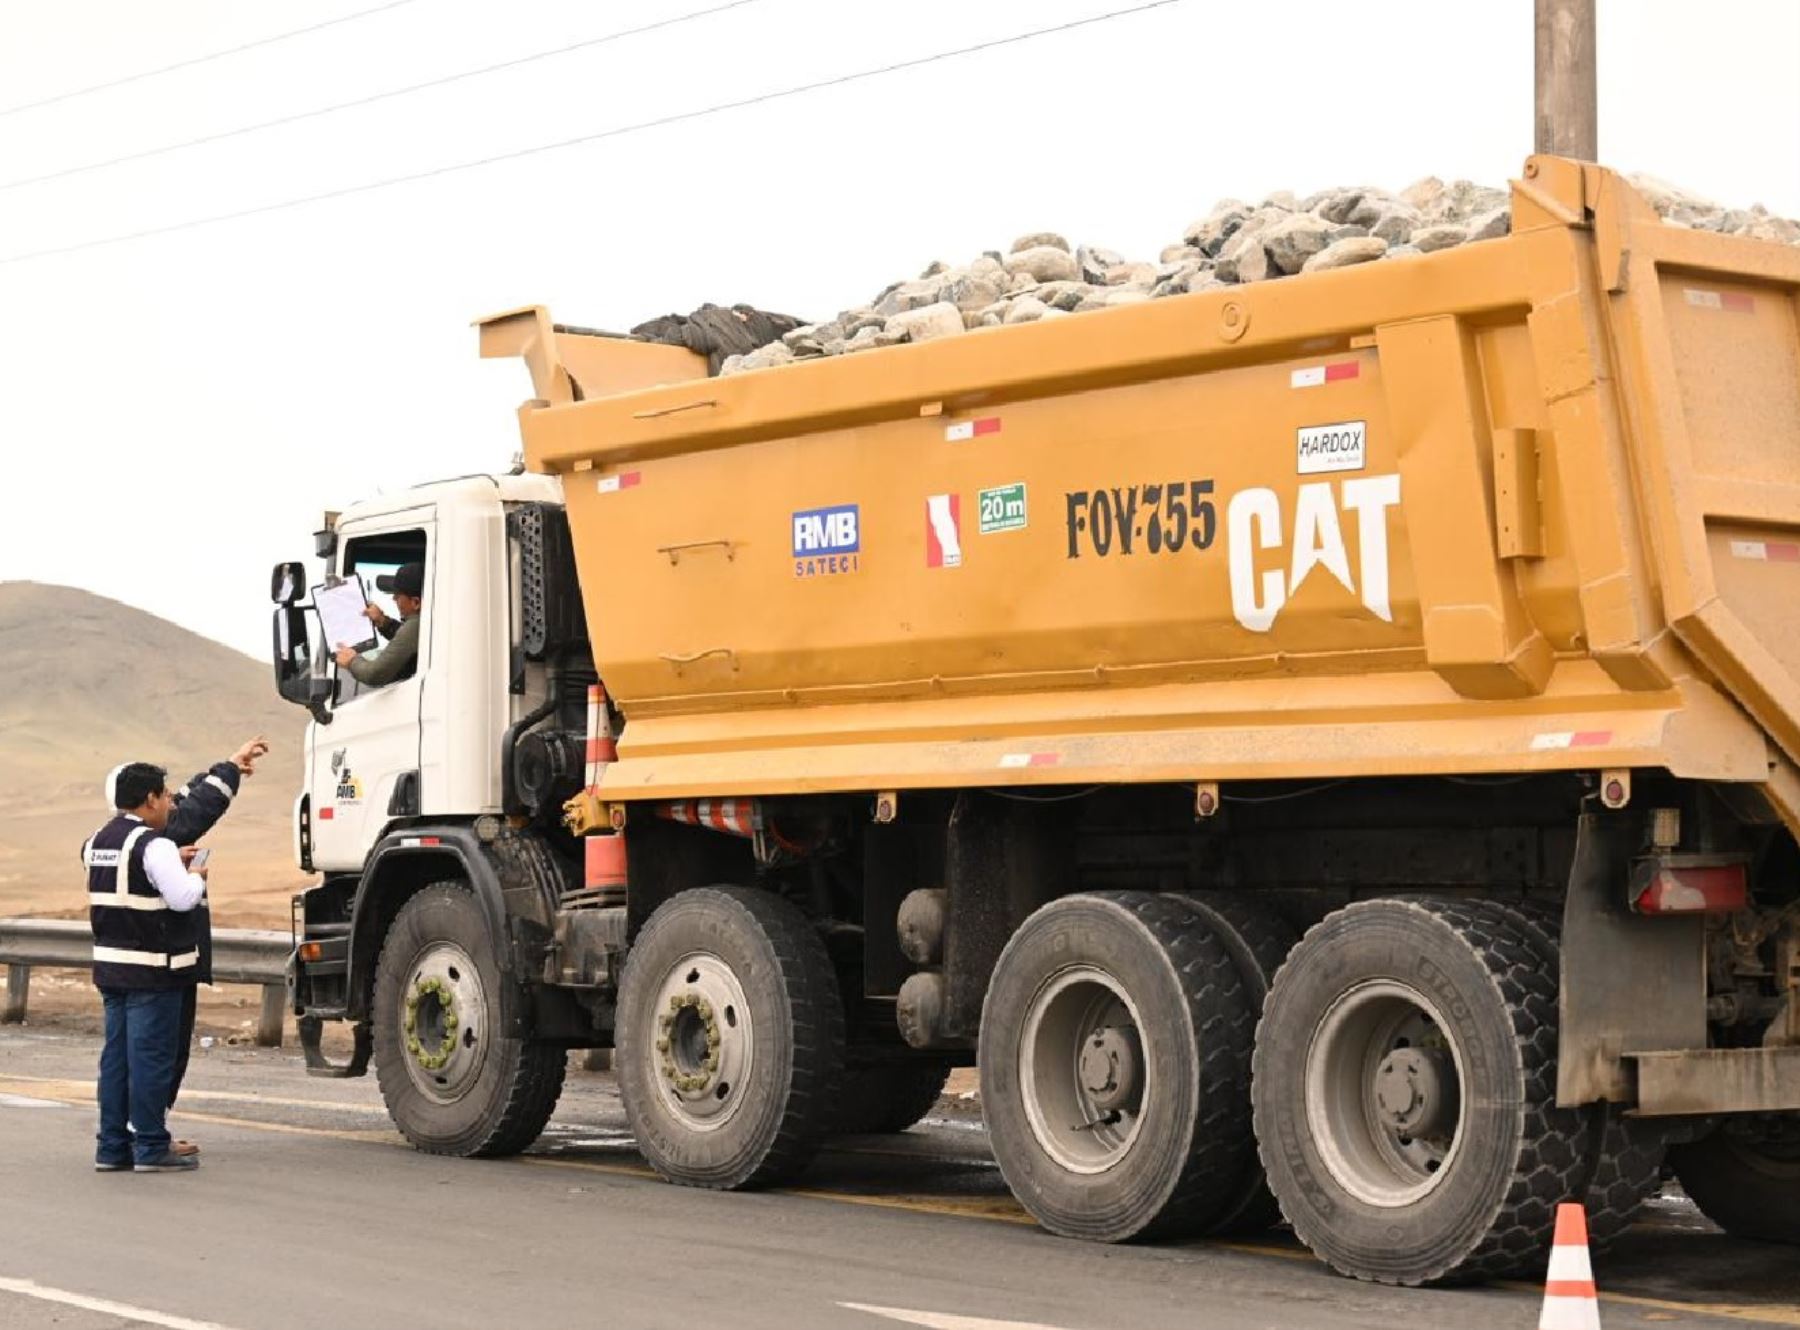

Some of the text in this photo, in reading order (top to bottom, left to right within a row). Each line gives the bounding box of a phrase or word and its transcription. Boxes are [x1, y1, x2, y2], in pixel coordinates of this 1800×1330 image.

[1299, 430, 1362, 457] HARDOX
[982, 495, 1024, 522] 20 m
[794, 512, 857, 553] RMB
[795, 555, 858, 577] SATECI
[1227, 473, 1401, 632] CAT
